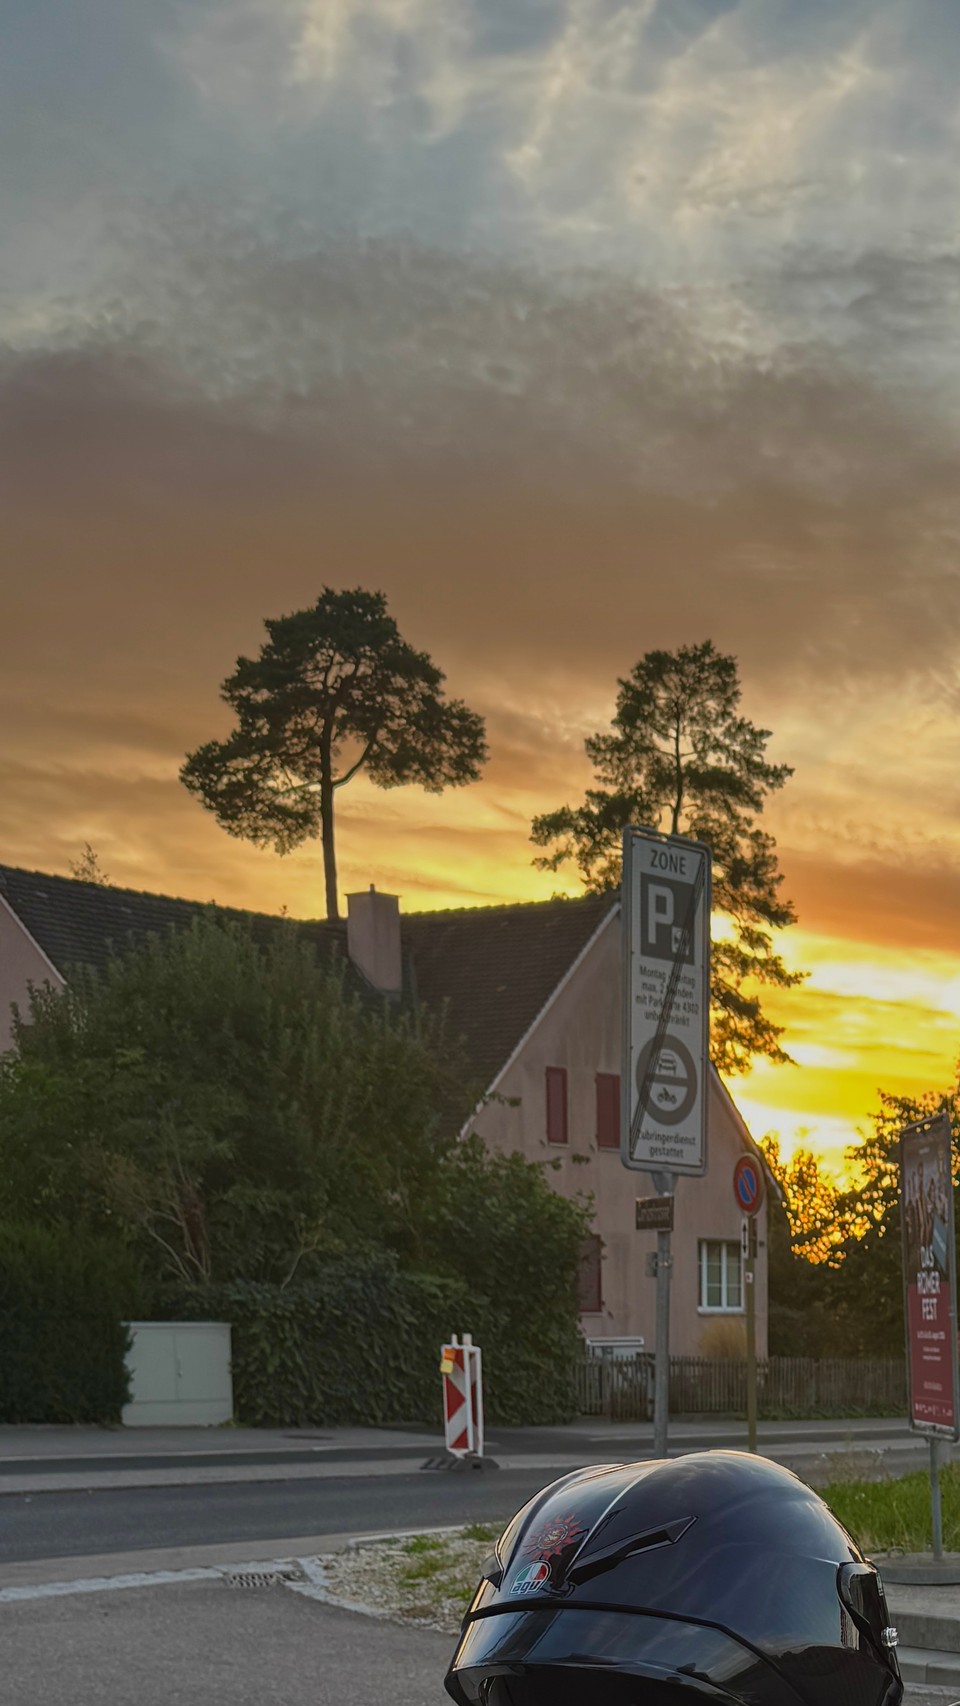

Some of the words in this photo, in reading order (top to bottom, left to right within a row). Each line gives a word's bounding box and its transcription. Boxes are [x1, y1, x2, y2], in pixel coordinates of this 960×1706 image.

[650, 848, 687, 875] ZONE
[647, 883, 674, 945] P
[639, 964, 666, 982] Montag
[649, 1146, 684, 1159] gestattet
[922, 1298, 937, 1321] FEST
